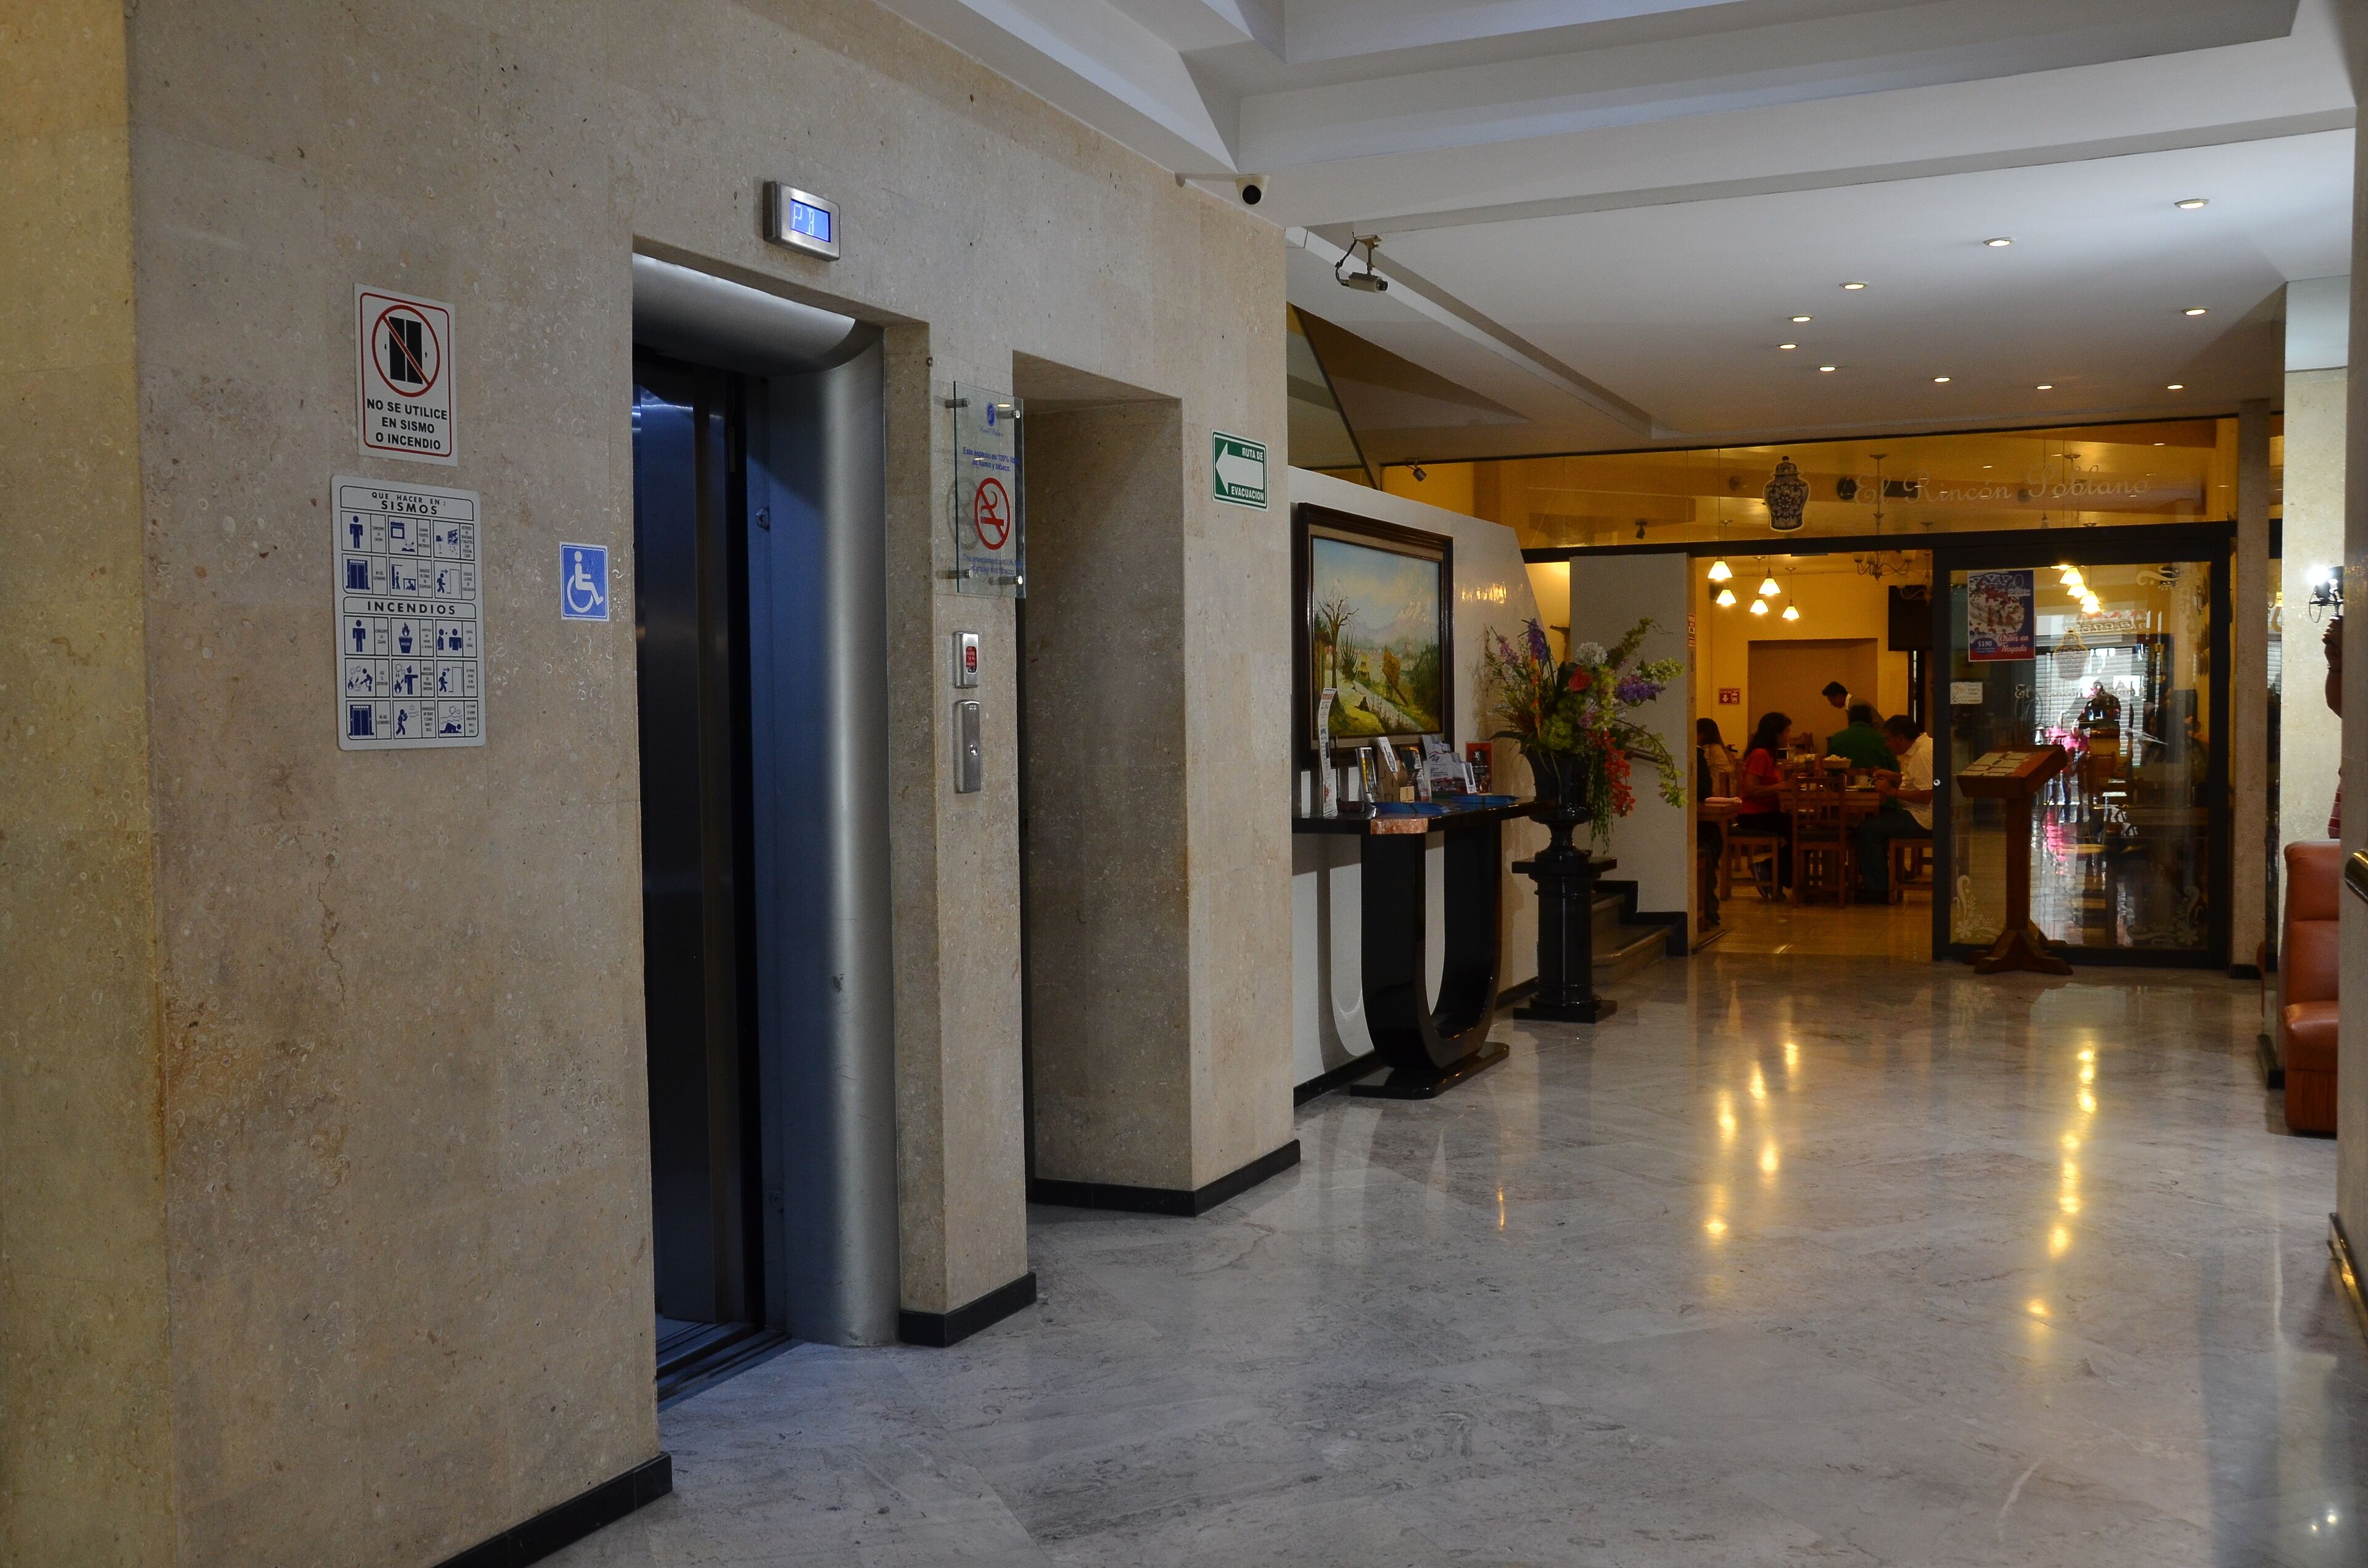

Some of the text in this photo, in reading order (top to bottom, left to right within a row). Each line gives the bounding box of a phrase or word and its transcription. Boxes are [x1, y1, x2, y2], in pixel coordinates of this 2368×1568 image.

[367, 398, 447, 421] NO SE UTILICE
[382, 417, 435, 433] EN SISMO
[376, 432, 441, 450] O INCENDIO
[1242, 447, 1264, 461] RUTA DE
[1854, 462, 2152, 504] El Rincón Poblano
[372, 491, 389, 499] QUE
[397, 495, 423, 503] HACER
[1231, 485, 1264, 501] EVACUACION
[381, 500, 437, 515] SISMOS
[367, 601, 456, 615] INCENDIOS
[1999, 633, 2018, 643] Chiles
[2002, 644, 2028, 654] Nogada
[2015, 684, 2031, 699] El
